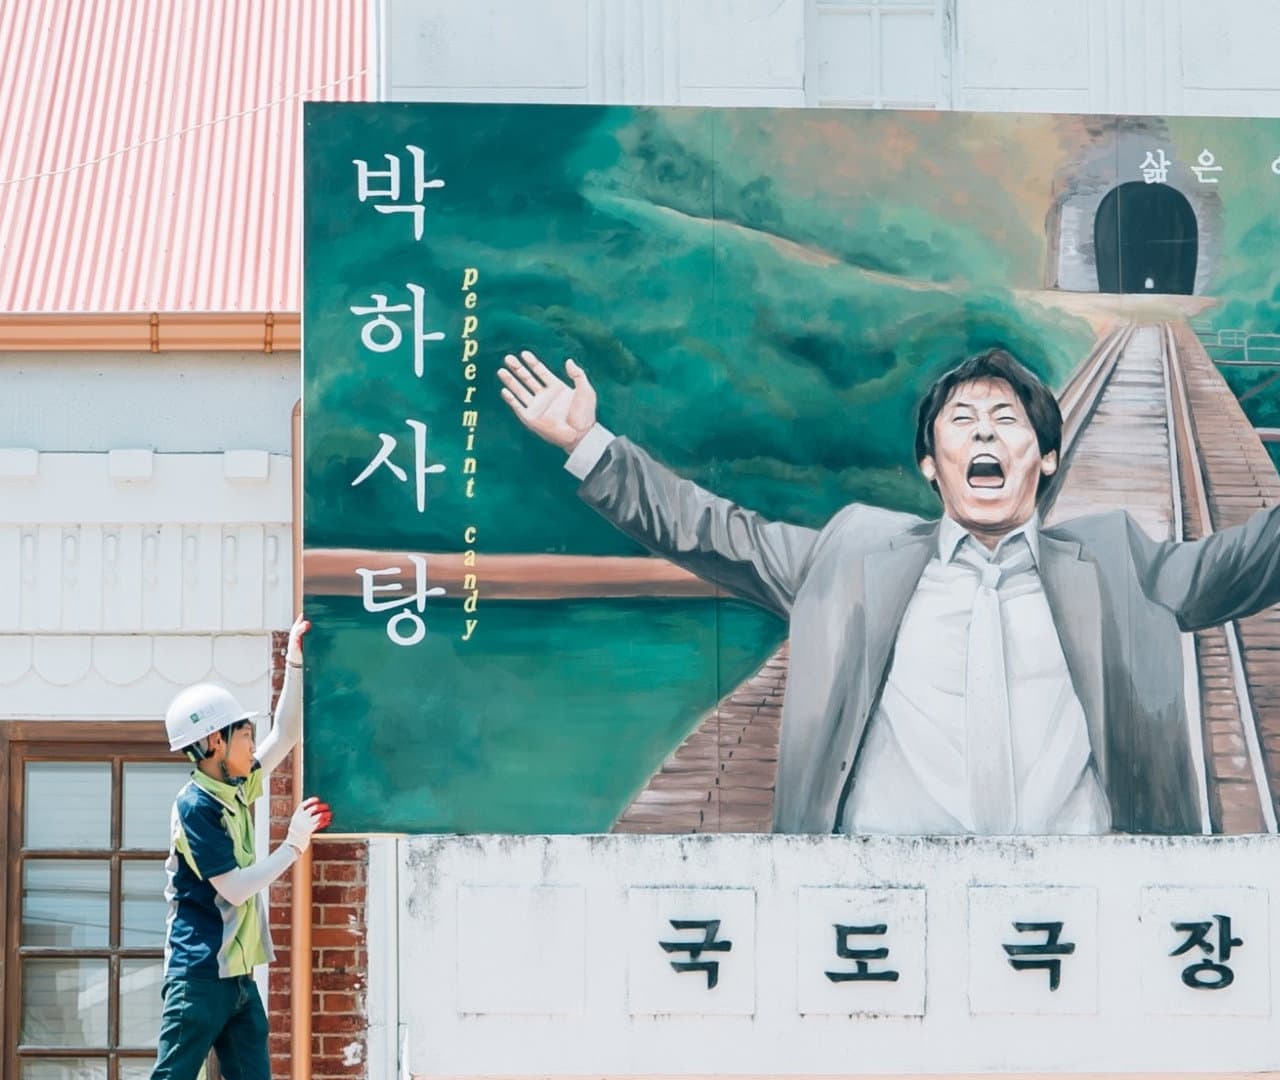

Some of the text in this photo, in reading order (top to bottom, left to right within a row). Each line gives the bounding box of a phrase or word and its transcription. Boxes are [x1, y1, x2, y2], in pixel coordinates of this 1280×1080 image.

[1139, 149, 1223, 185] 삶은
[350, 144, 446, 647] 박하사탕
[461, 267, 480, 641] peppermint candy
[658, 914, 1244, 992] 국도극장
